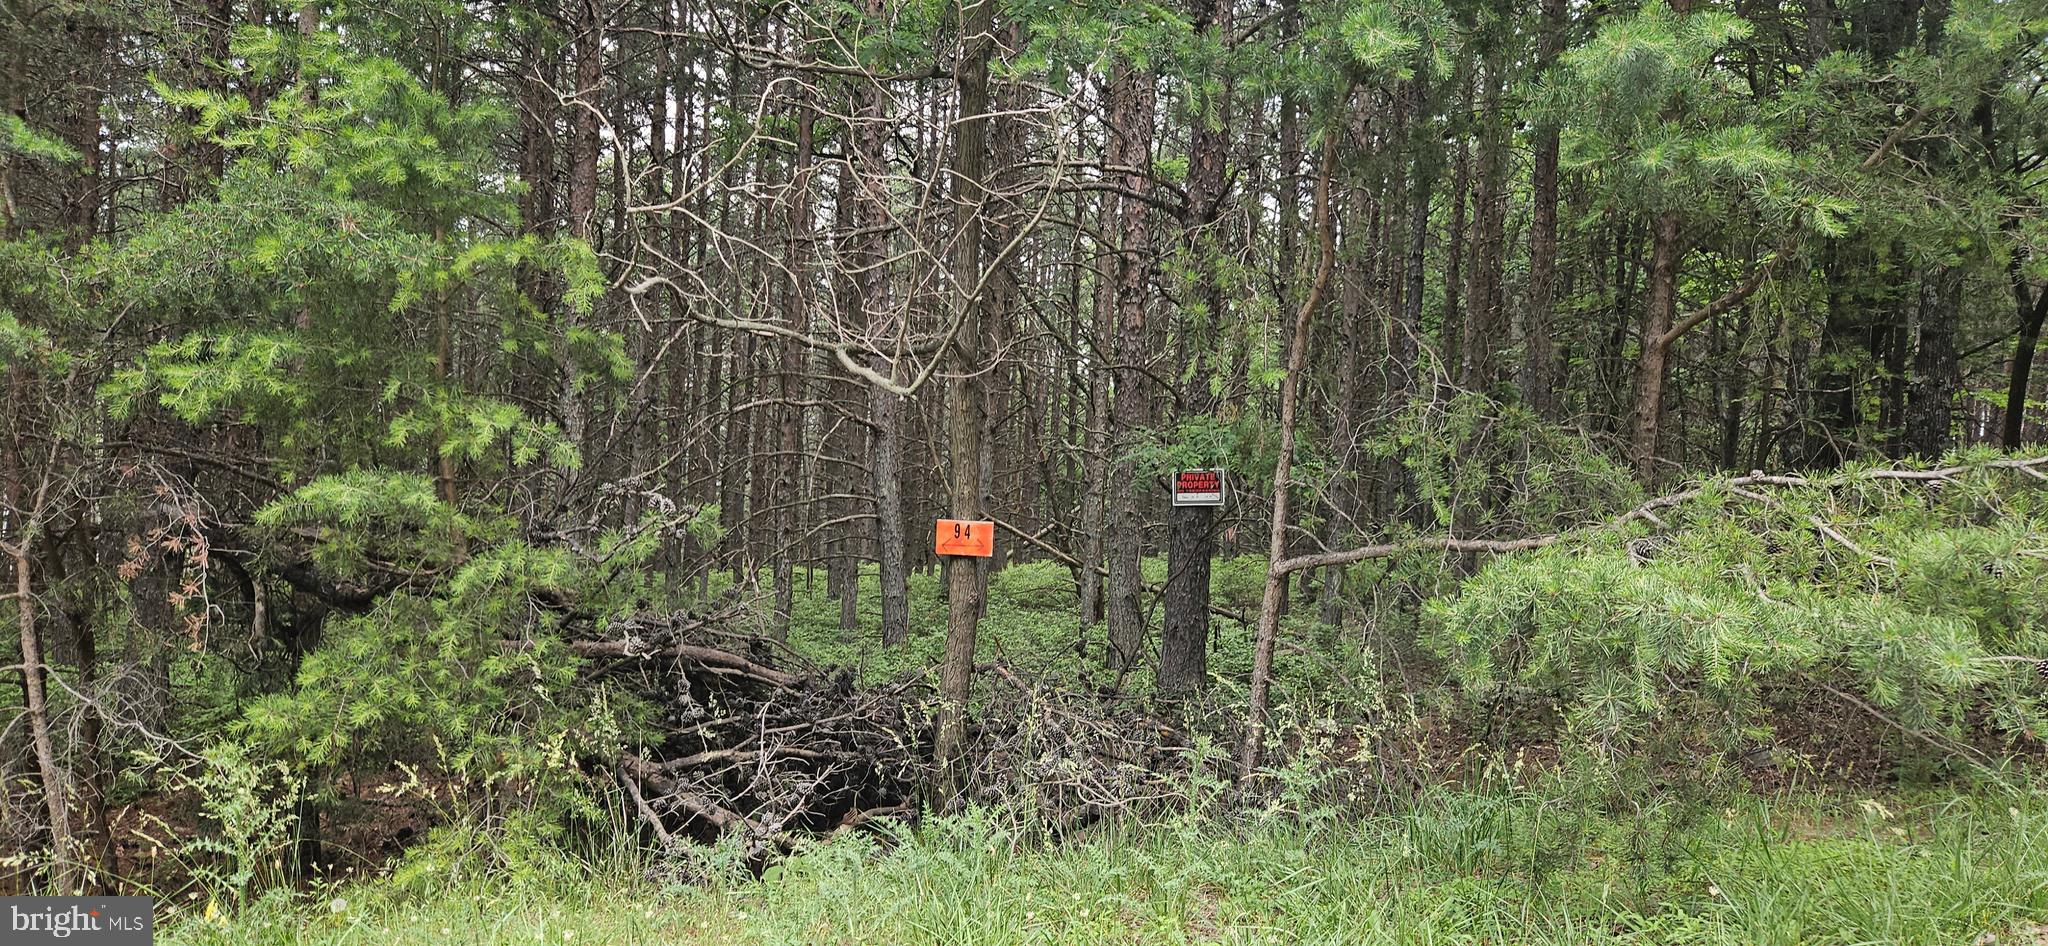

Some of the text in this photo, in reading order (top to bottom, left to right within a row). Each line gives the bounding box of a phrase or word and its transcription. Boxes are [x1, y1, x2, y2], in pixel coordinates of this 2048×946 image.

[1181, 472, 1216, 480] PRIVATE
[1177, 480, 1220, 489] PROPERTY
[954, 523, 970, 539] 94
